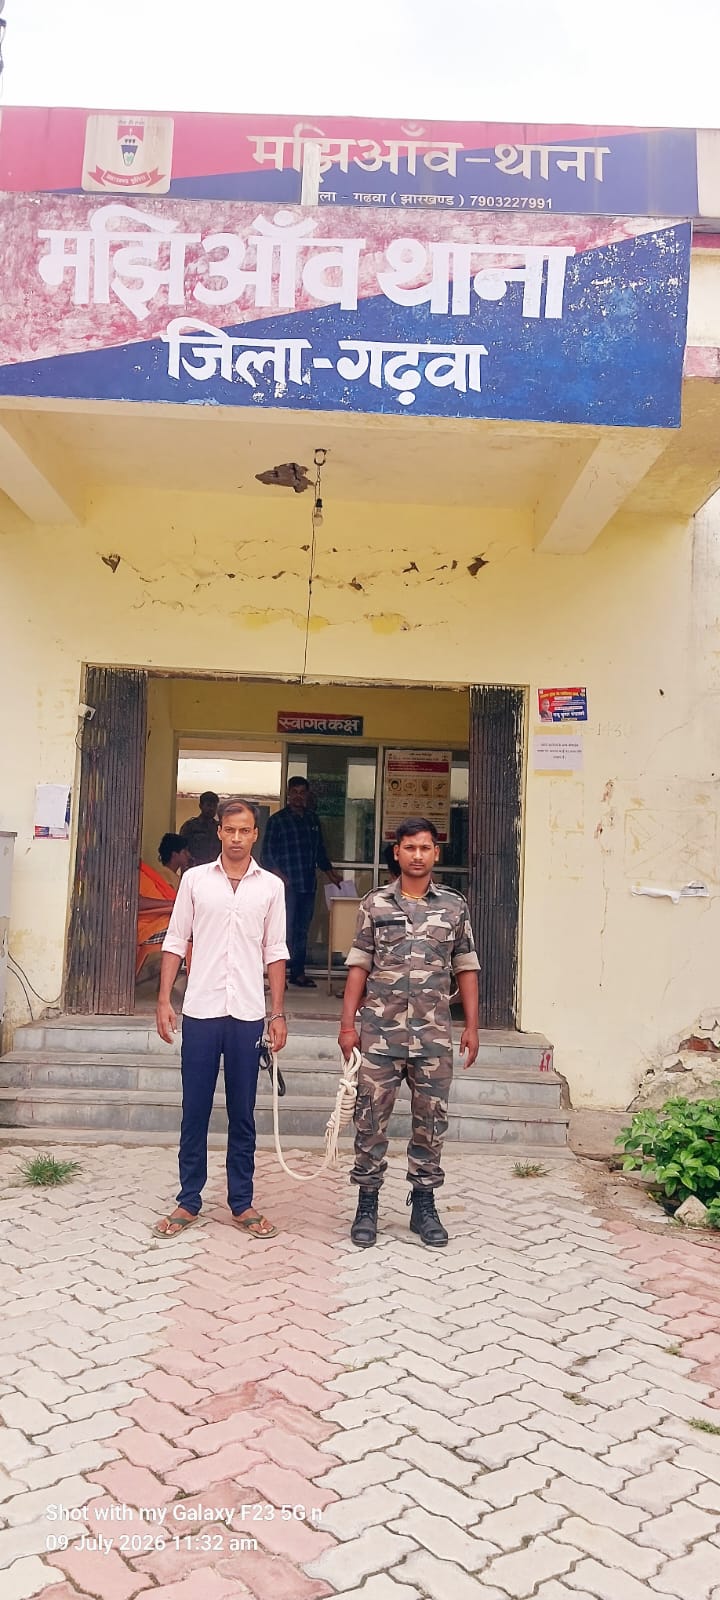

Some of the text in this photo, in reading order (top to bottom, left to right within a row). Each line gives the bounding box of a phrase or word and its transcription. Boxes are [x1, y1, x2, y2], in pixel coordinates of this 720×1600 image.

[318, 191, 337, 202] ला
[399, 194, 454, 206] झारखण्ड
[469, 195, 552, 208] 7903227991
[376, 238, 576, 319] थाना
[160, 317, 488, 406] जिला-गढ़वा
[278, 717, 360, 733] स्वागत कक्ष
